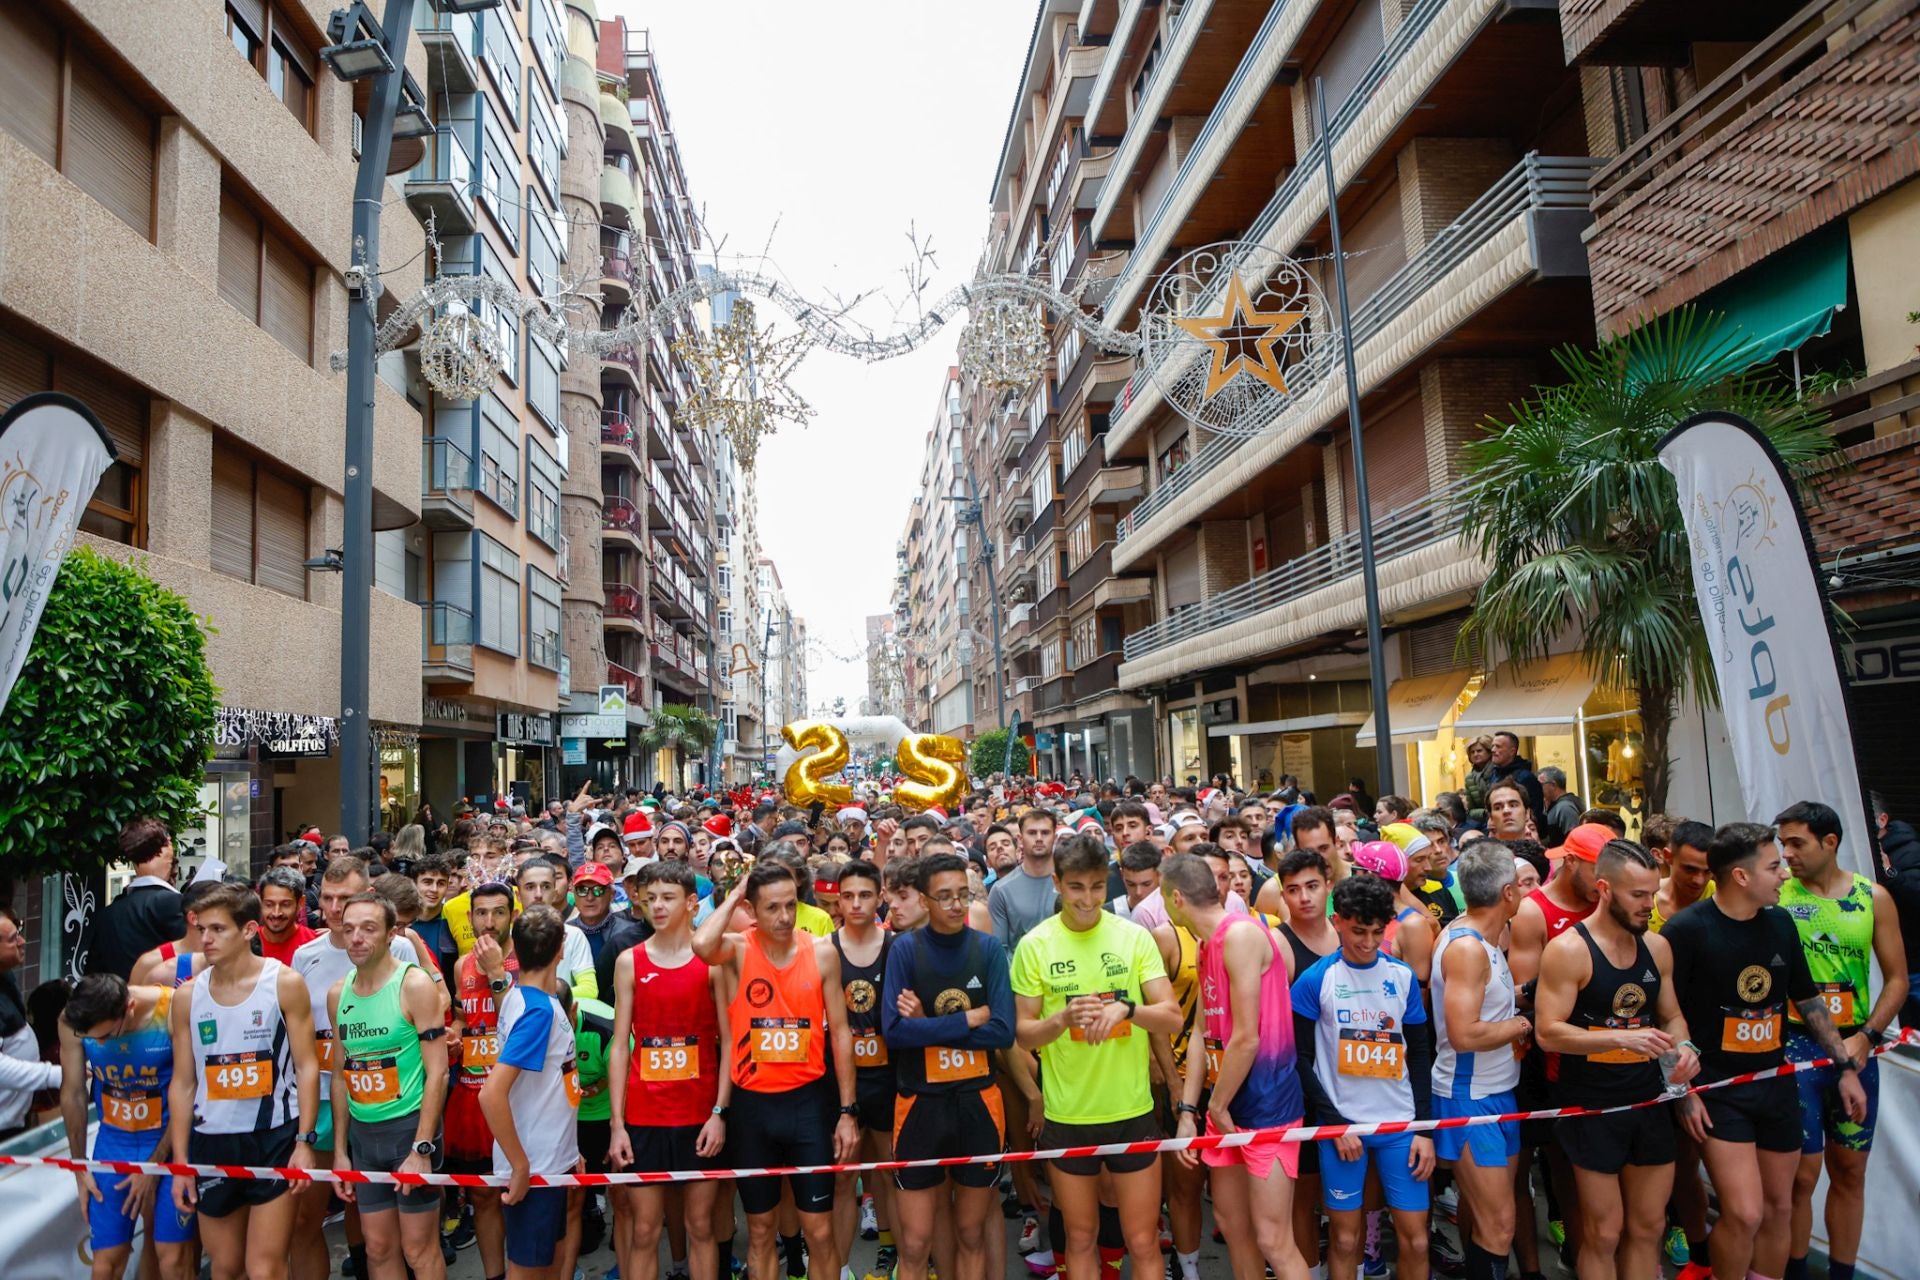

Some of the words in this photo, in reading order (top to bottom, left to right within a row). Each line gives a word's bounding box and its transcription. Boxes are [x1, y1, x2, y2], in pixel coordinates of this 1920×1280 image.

[269, 738, 327, 752] GOLFITOS
[349, 1021, 367, 1035] pan
[350, 1026, 389, 1039] moreno
[1736, 1021, 1773, 1042] 800
[471, 1038, 499, 1056] 783
[760, 1032, 799, 1051] 203
[650, 1050, 688, 1070] 539
[938, 1049, 976, 1070] 561
[1344, 1043, 1398, 1066] 1044
[217, 1066, 259, 1089] 495
[350, 1072, 386, 1093] 503
[110, 1100, 149, 1121] 730
